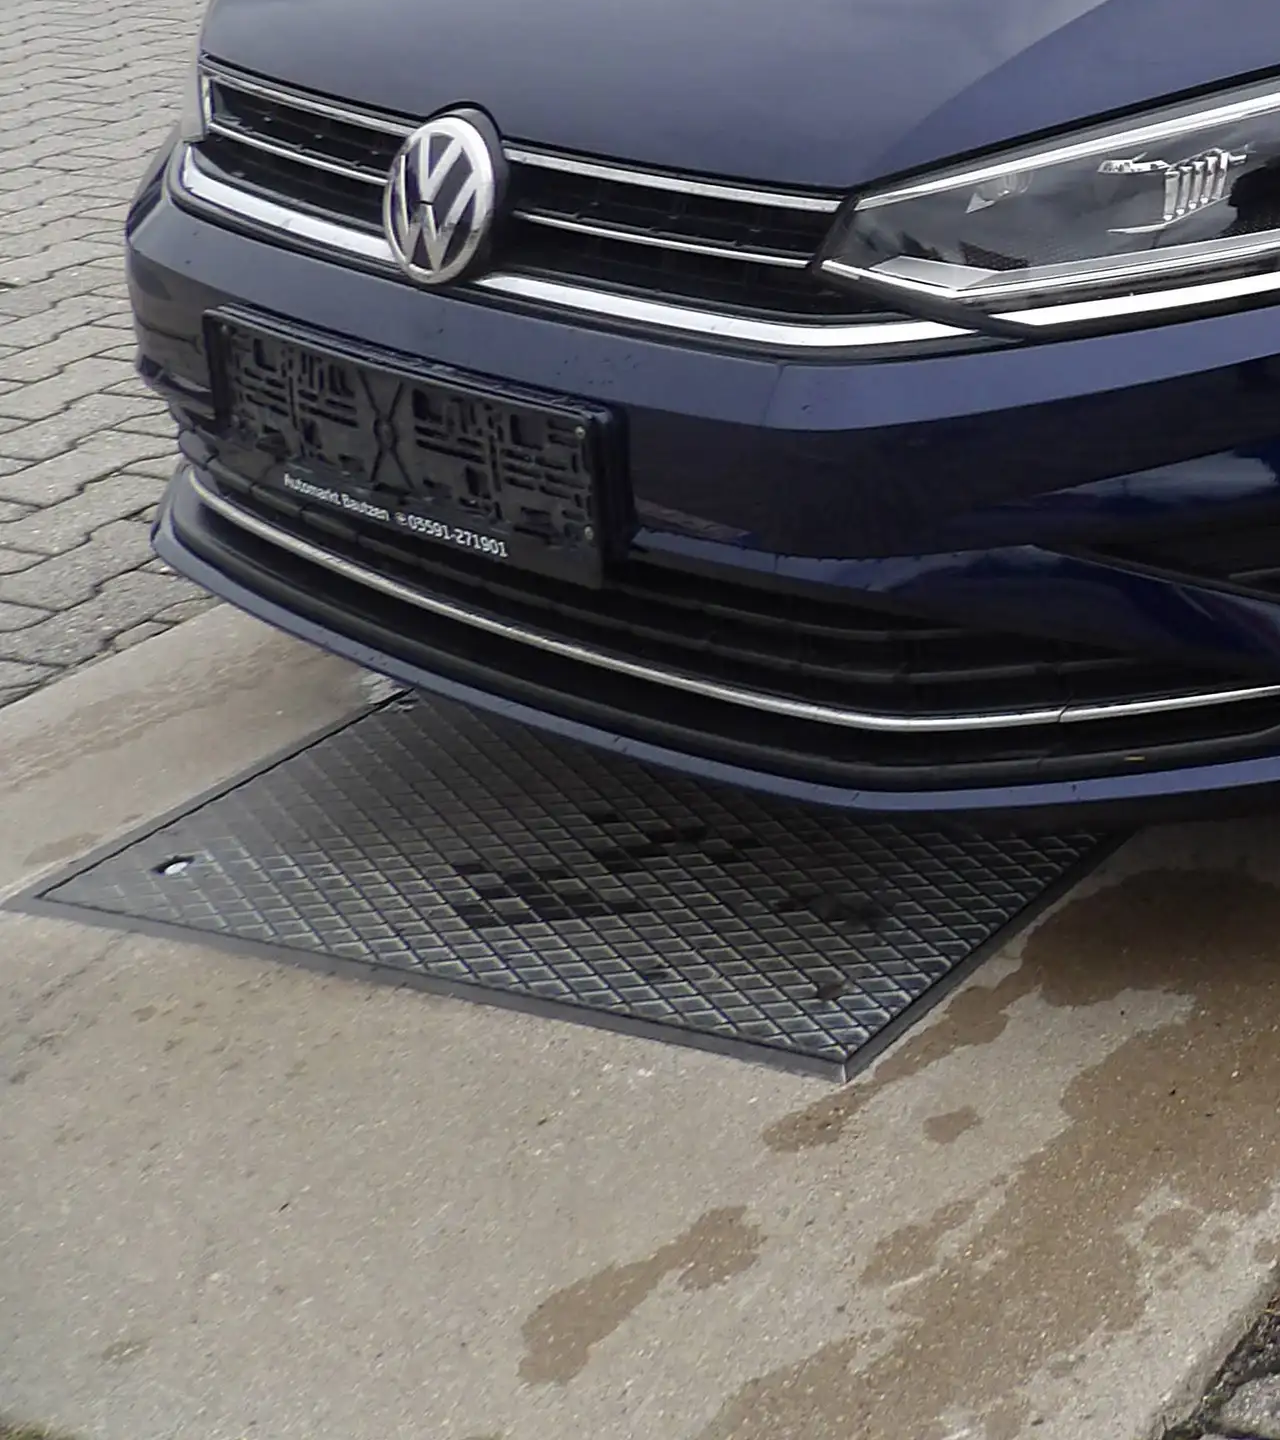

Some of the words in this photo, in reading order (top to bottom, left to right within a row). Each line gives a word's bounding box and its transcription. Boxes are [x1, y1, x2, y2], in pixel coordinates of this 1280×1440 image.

[384, 118, 493, 283] VW
[284, 472, 342, 506] Automarkt
[341, 492, 390, 522] Bautzen
[407, 514, 509, 558] 03591-271901
